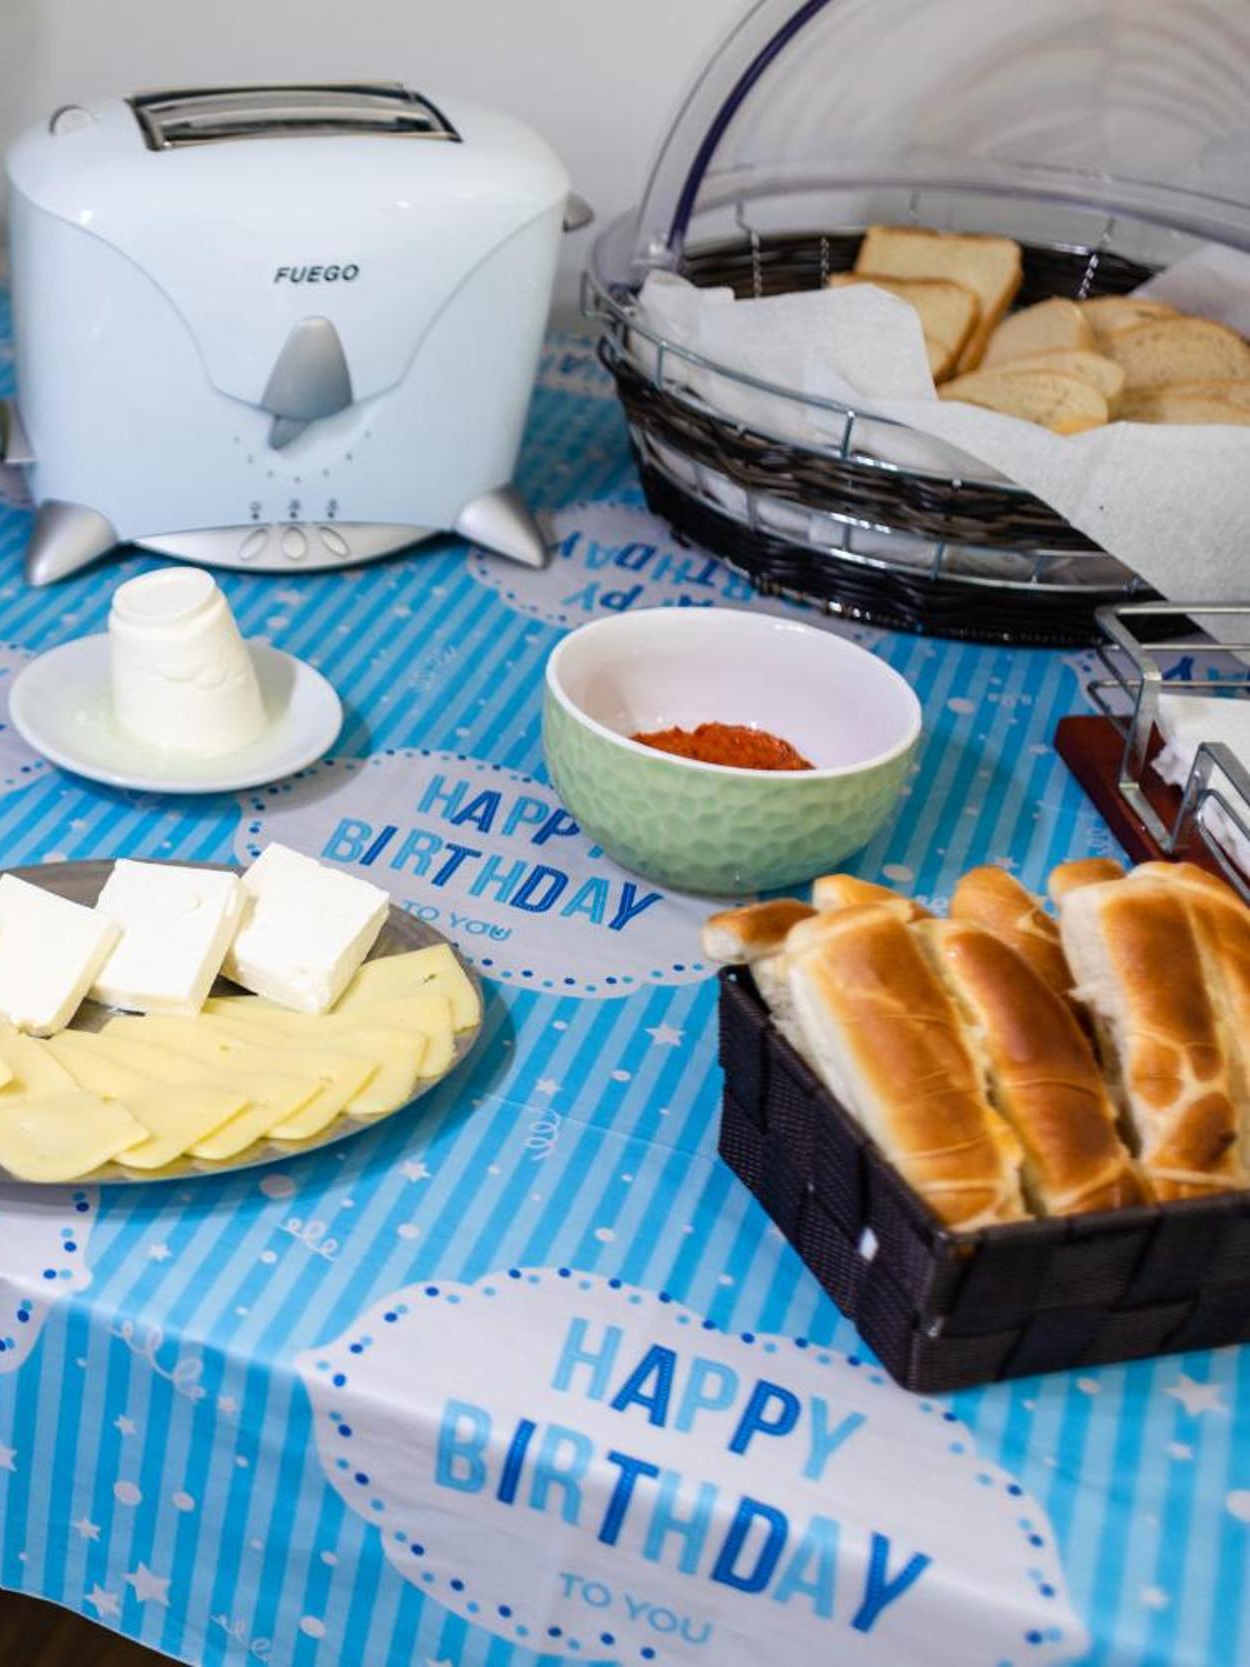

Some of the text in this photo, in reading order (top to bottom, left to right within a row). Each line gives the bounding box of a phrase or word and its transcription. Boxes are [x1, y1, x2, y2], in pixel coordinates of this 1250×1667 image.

[273, 264, 360, 283] FUEGO
[417, 774, 606, 859] HAPP
[320, 818, 664, 931] BIRTHDAY
[404, 900, 511, 941] TO YOU
[549, 1316, 868, 1482] HAPPY
[434, 1397, 933, 1635] BIRTHDAY
[559, 1572, 715, 1645] TO YOU
